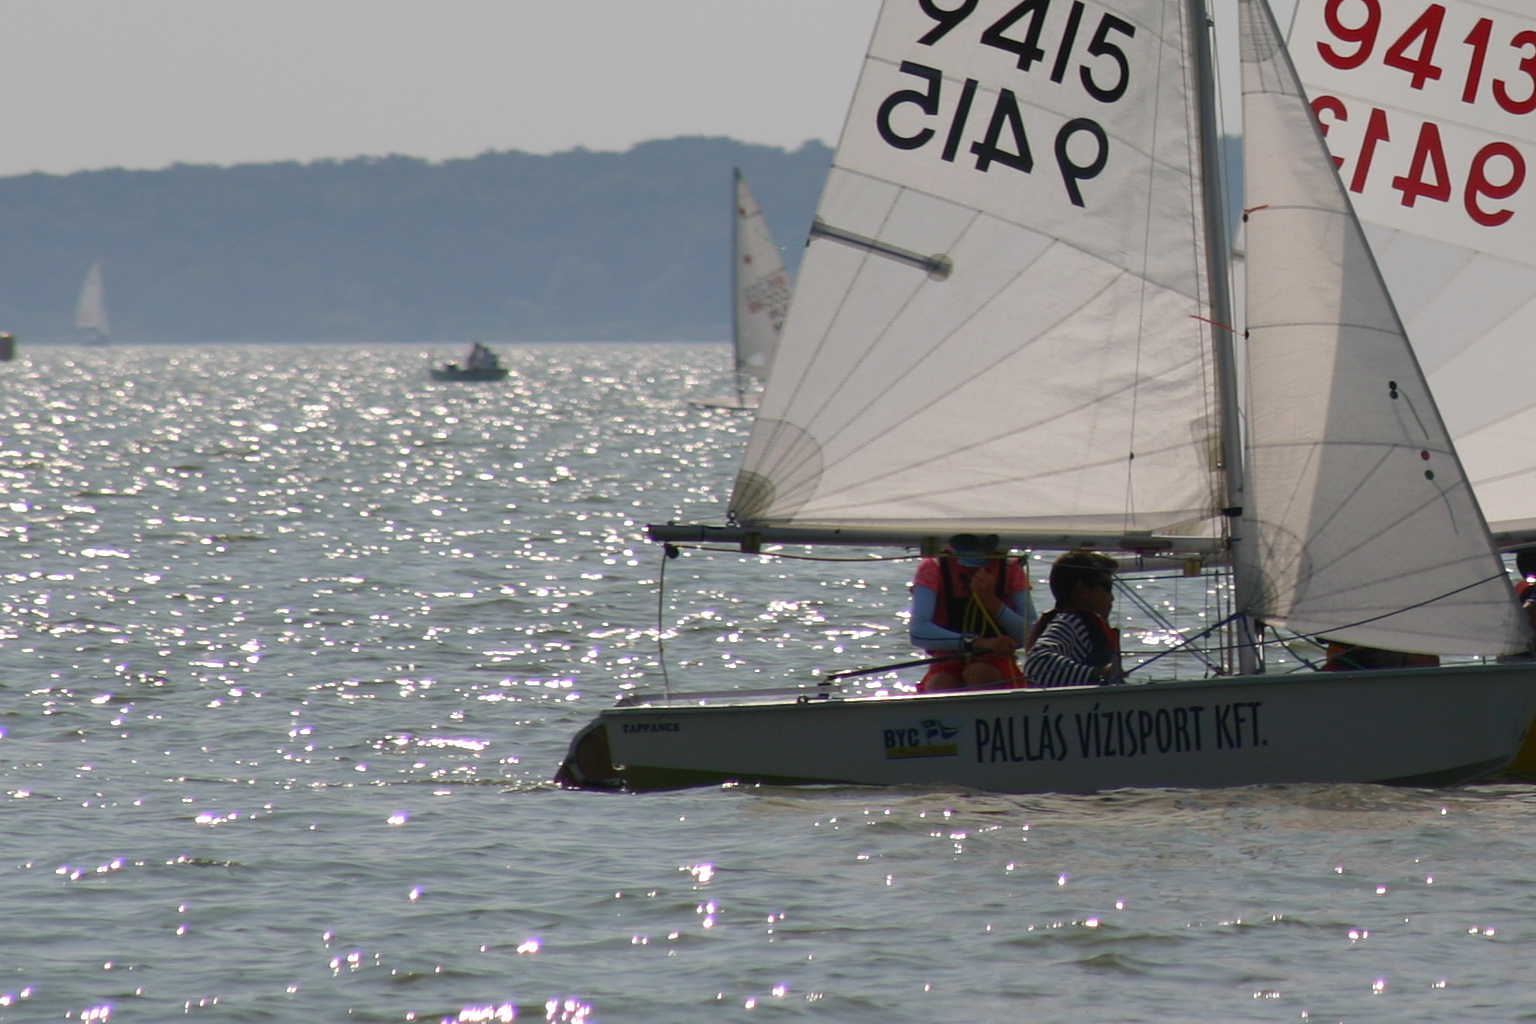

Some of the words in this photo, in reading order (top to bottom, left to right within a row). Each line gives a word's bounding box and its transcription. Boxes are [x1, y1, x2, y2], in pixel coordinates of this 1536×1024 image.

[884, 728, 920, 748] BYC
[975, 704, 1067, 763] PALLÁS
[1075, 702, 1204, 759] VÍZISPORT
[1214, 702, 1269, 750] KFT.
